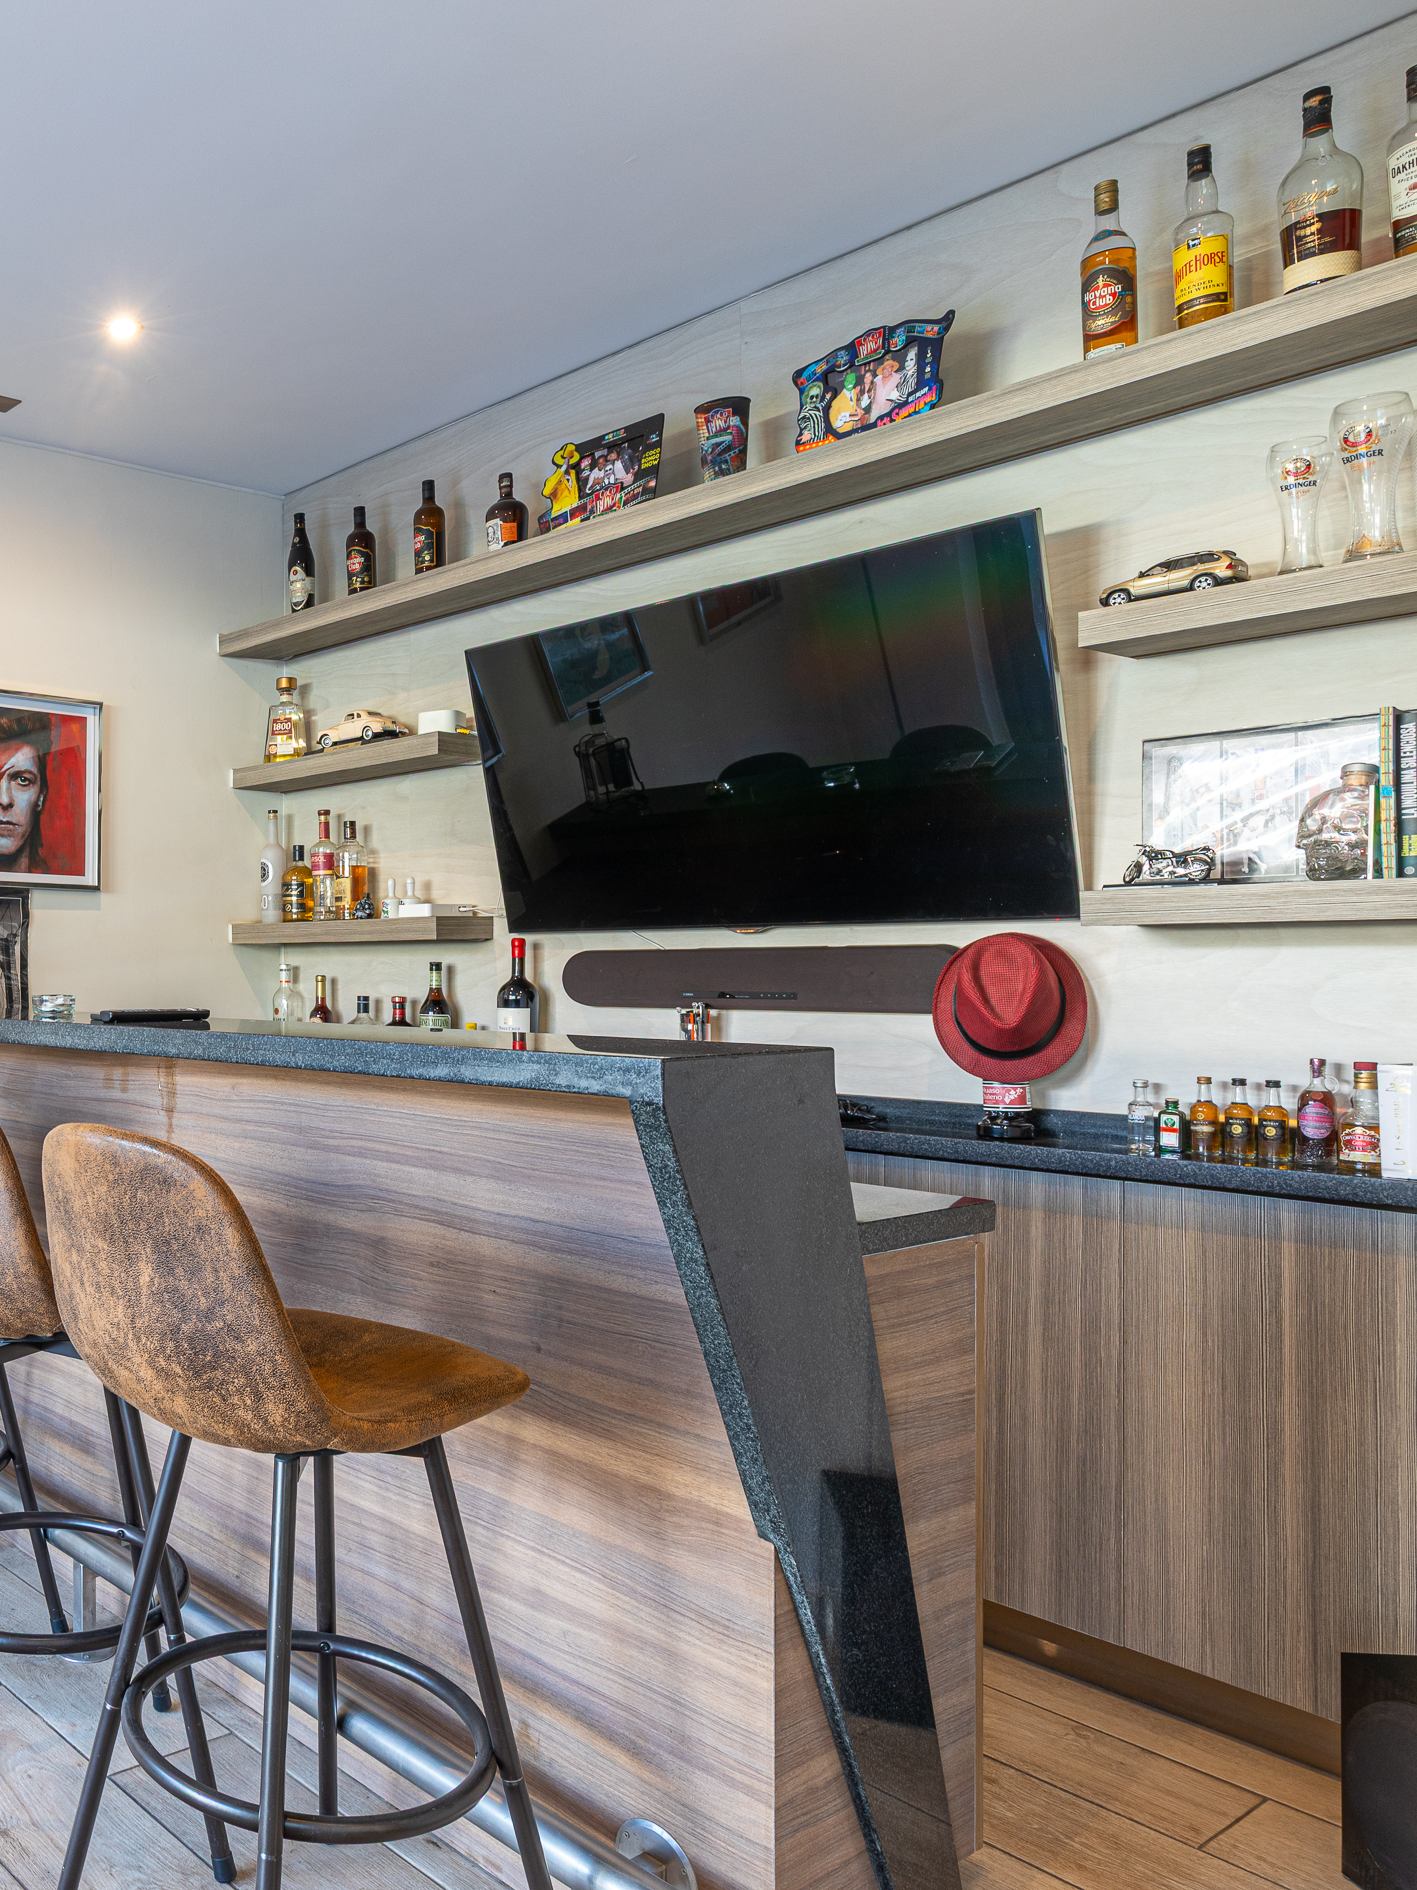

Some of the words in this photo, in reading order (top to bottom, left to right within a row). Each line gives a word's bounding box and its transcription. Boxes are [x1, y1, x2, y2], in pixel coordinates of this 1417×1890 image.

[1281, 185, 1340, 219] Zacapa
[1194, 250, 1226, 272] HORSE
[1180, 279, 1213, 293] BLENDED
[1195, 282, 1225, 292] WHISKY
[1084, 285, 1122, 302] Havana
[1090, 295, 1114, 308] Club
[1085, 312, 1122, 331] Especial
[641, 454, 660, 464] BONGO
[641, 458, 659, 469] SHOW
[1342, 449, 1384, 465] ERDINGER
[1280, 480, 1317, 492] ERDINGER
[273, 722, 291, 731] 1800
[1400, 722, 1417, 768] SILENCIOSA
[1401, 768, 1417, 807] INQUILINA
[1402, 807, 1417, 818] LA
